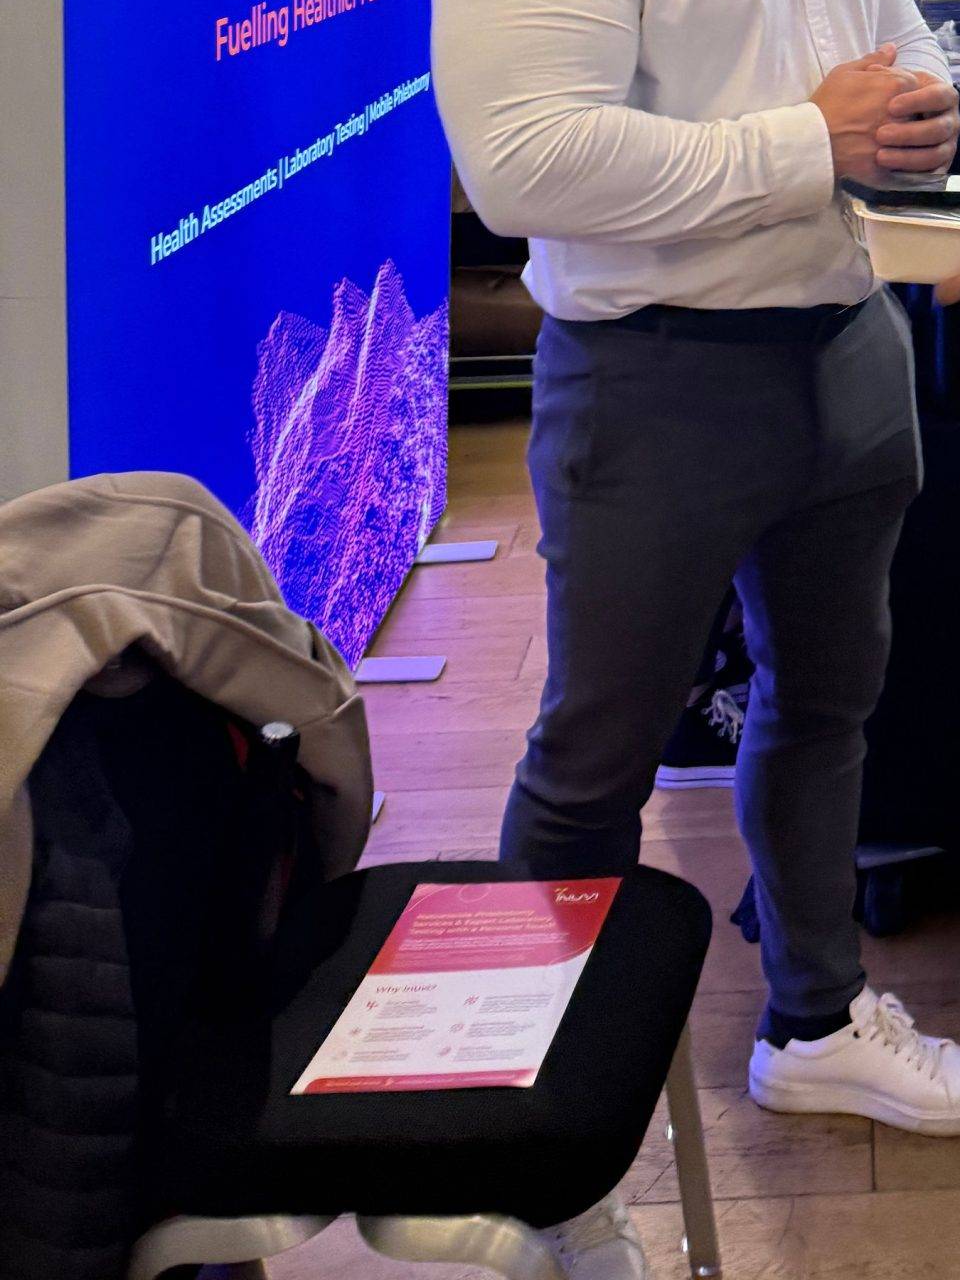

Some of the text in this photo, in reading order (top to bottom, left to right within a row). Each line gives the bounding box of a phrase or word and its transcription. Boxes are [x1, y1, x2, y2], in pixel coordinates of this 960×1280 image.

[215, 1, 289, 62] Fuelling
[151, 212, 199, 265] Health
[200, 167, 278, 235] Assessments
[284, 131, 335, 180] Laboratory
[334, 113, 365, 146] Testing
[369, 92, 393, 124] Mobile
